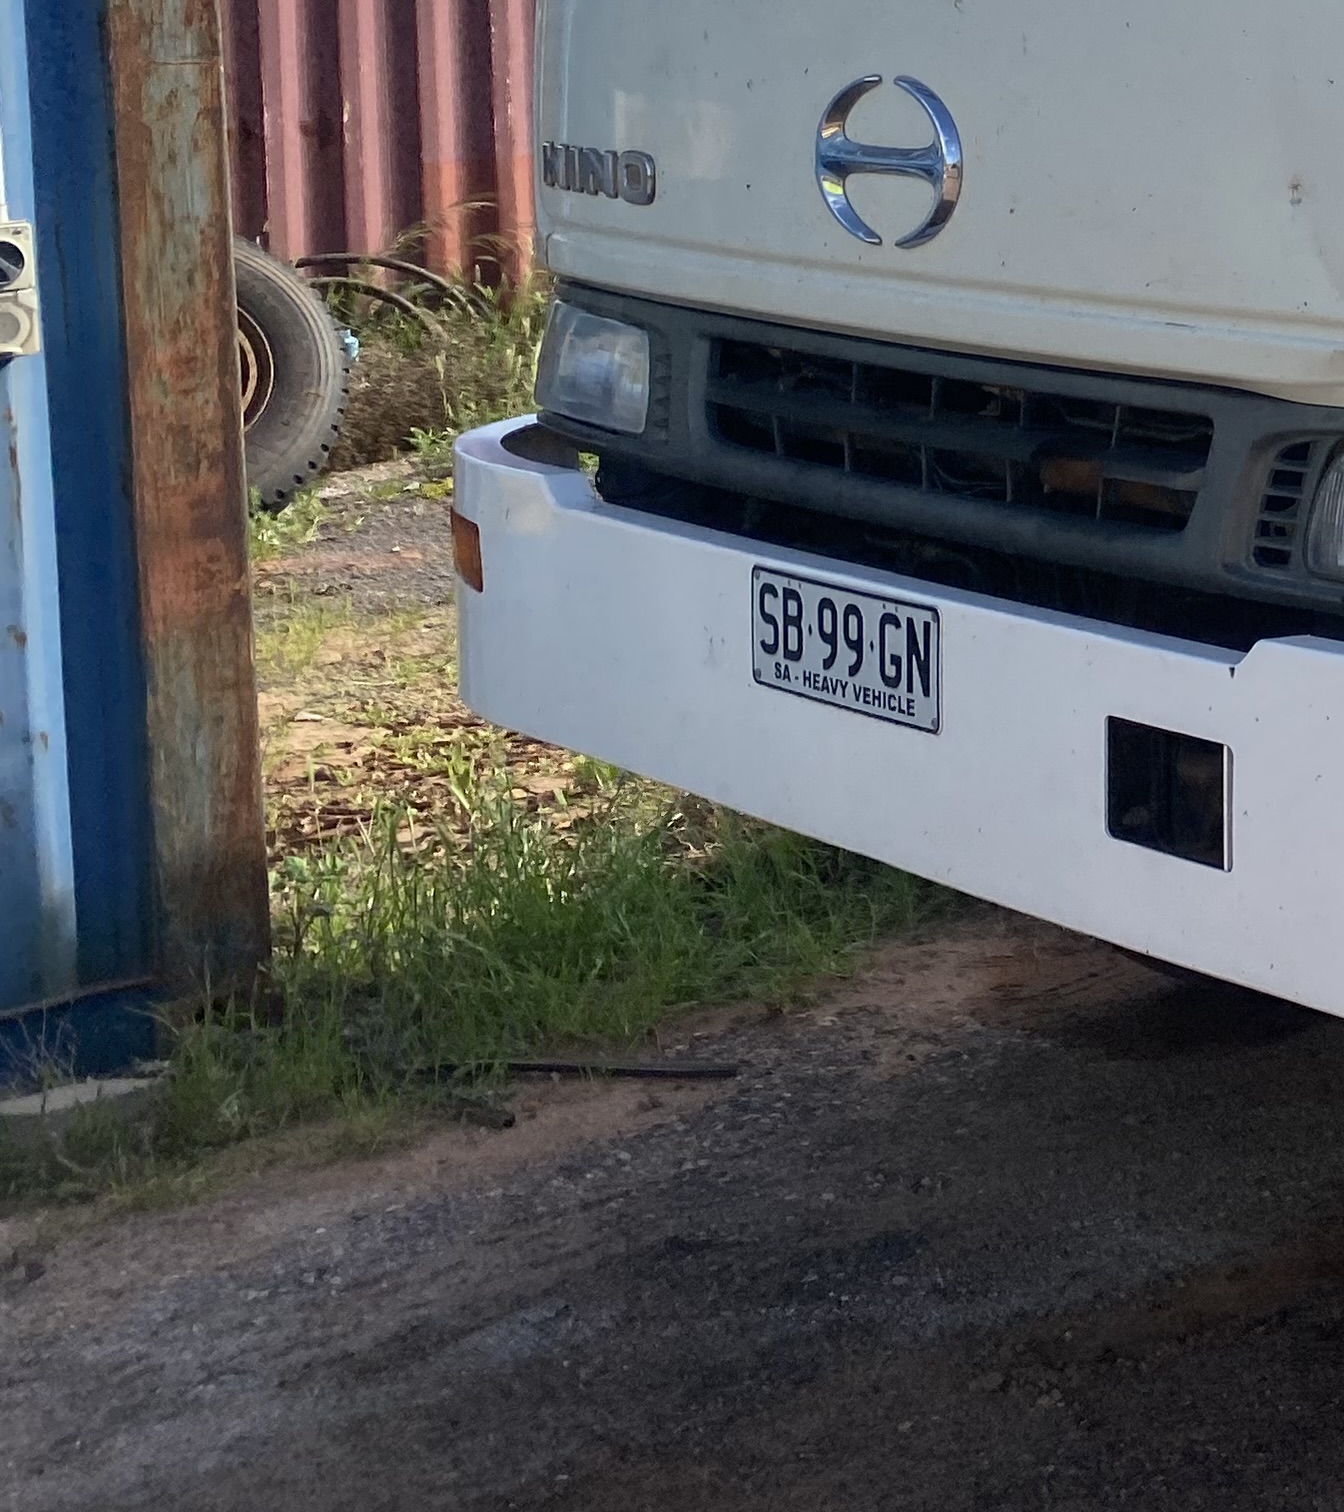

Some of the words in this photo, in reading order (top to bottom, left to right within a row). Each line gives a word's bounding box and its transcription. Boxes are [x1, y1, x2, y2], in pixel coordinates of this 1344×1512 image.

[542, 140, 657, 206] HINO
[774, 661, 791, 681] SA
[802, 670, 849, 698] HEAVY
[852, 683, 916, 717] VEHICLE
